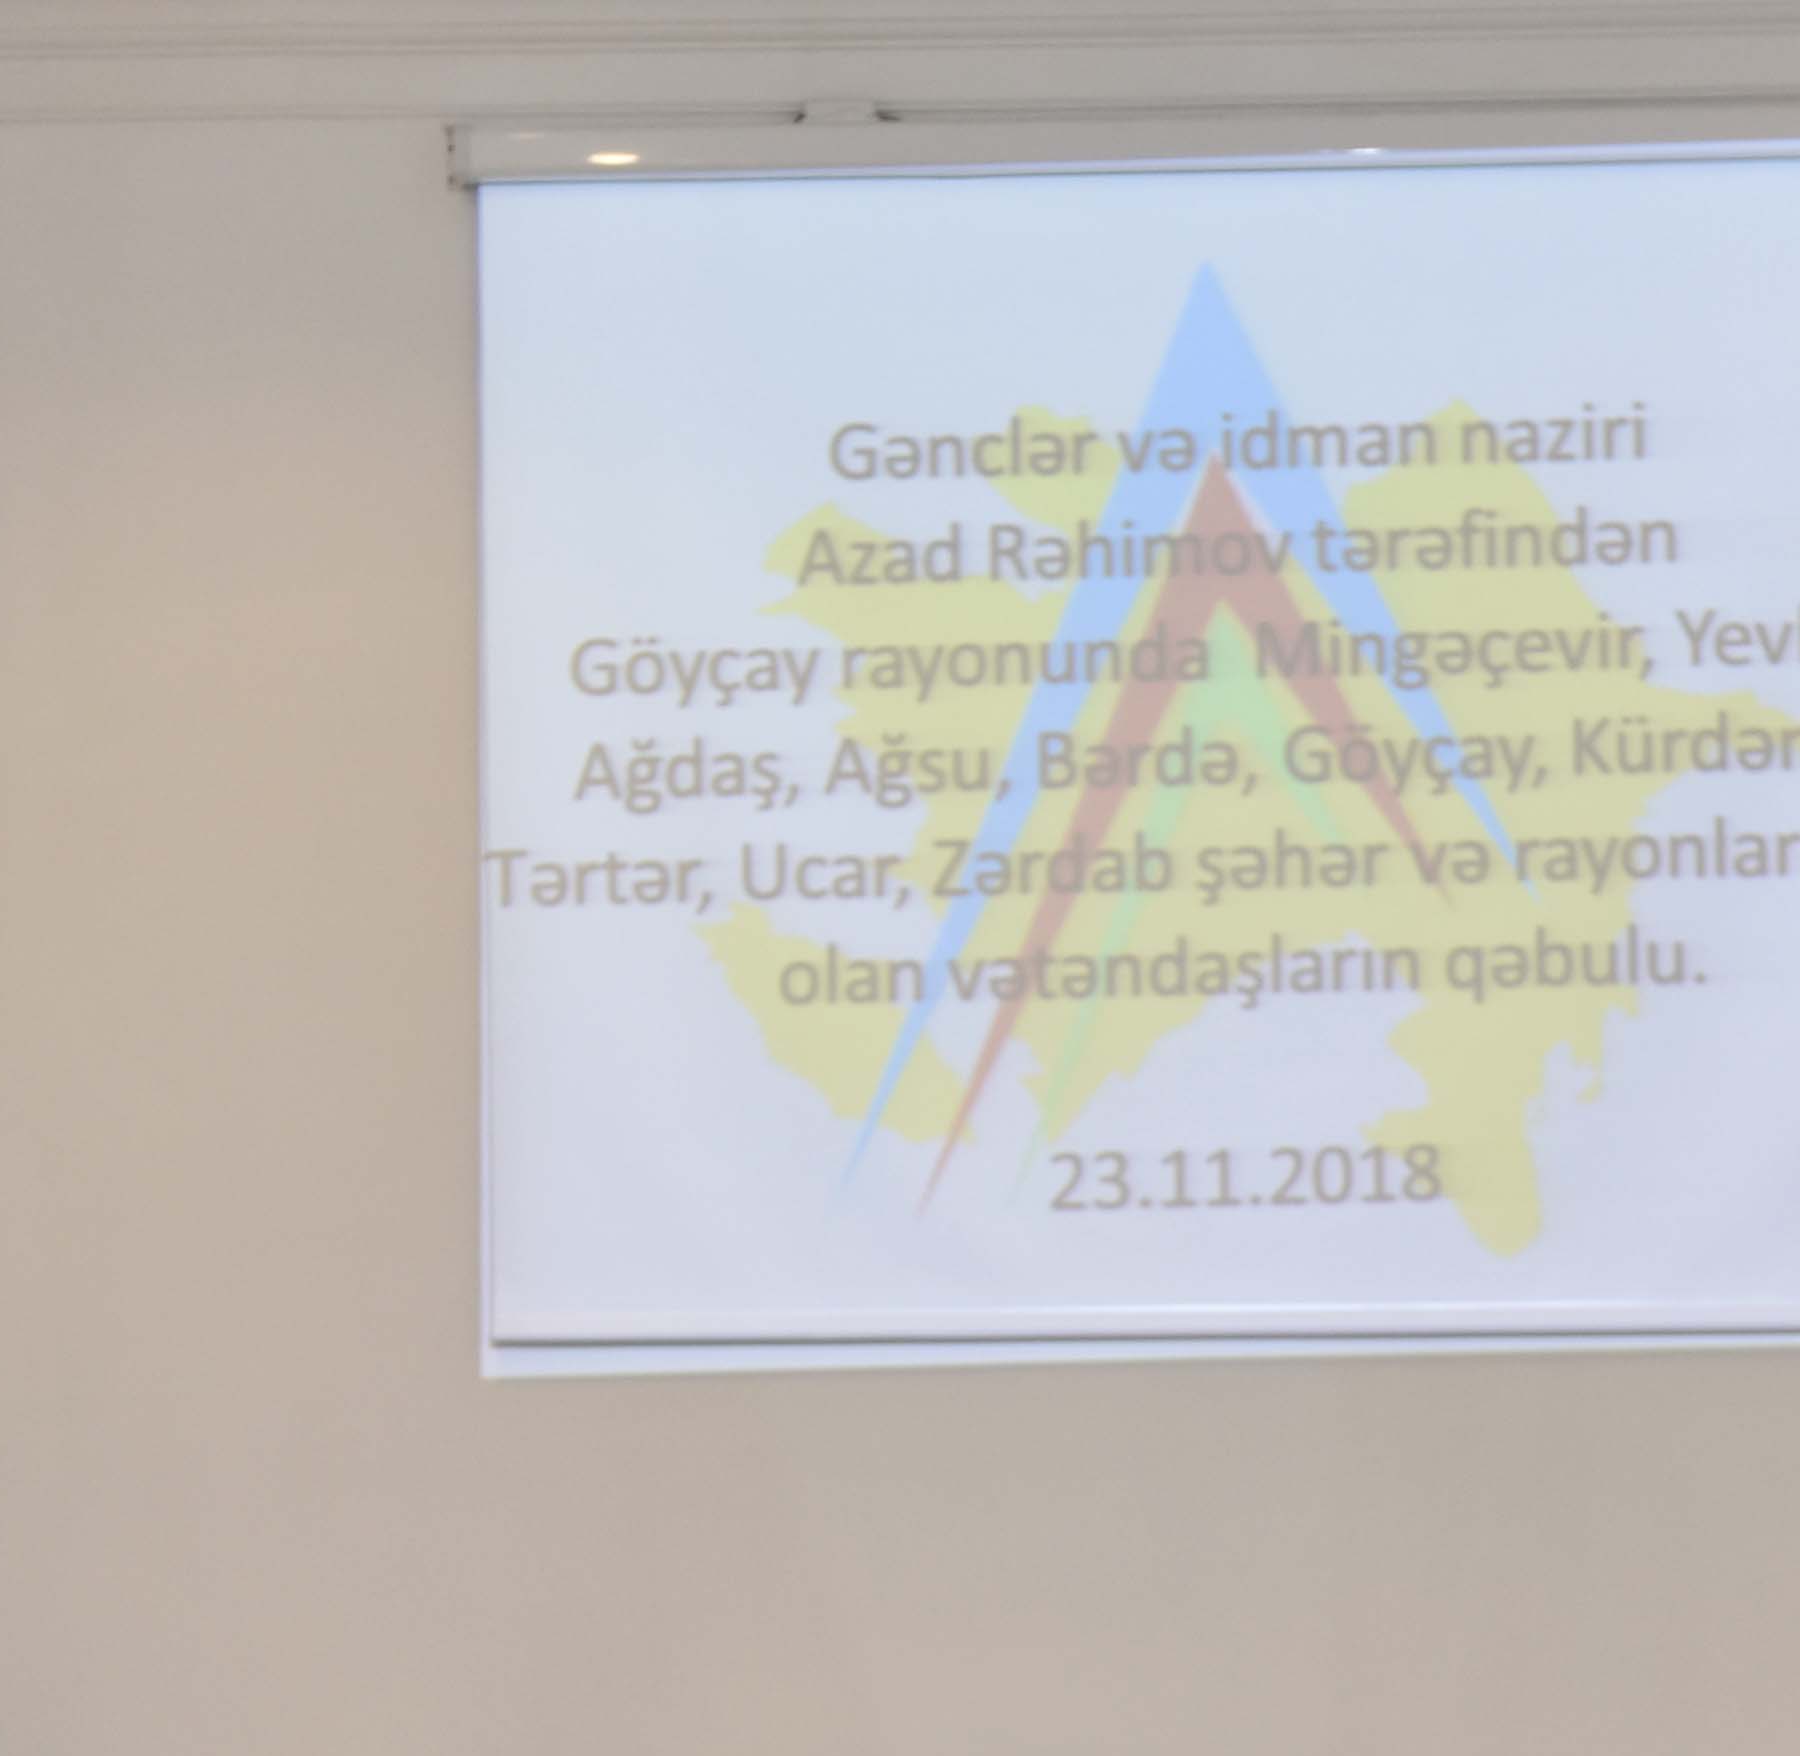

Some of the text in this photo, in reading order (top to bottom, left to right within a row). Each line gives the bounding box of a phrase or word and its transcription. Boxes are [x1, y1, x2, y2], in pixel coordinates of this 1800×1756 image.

[829, 404, 1649, 481] Gənclər və idman naziri
[797, 507, 1680, 586] Azad Rəhimov tərəfindən
[570, 636, 821, 707] Göyçay
[841, 622, 1212, 703] rayonunda
[1255, 611, 1656, 690] Mingəçevir,
[573, 738, 801, 815] Ağdaş,
[824, 733, 1012, 810] Ağsu,
[1037, 726, 1260, 798] Bərdə,
[1283, 721, 1548, 795] Göyçay,
[484, 849, 714, 914] Tərtər,
[741, 843, 912, 908] Ucar,
[931, 832, 1175, 898] Zərdab
[1194, 828, 1388, 905] şəhər
[1416, 837, 1491, 885] və
[779, 923, 1711, 1010] olan vətəndaşların qəbulu.
[1049, 1142, 1442, 1212] 23.11.2018
